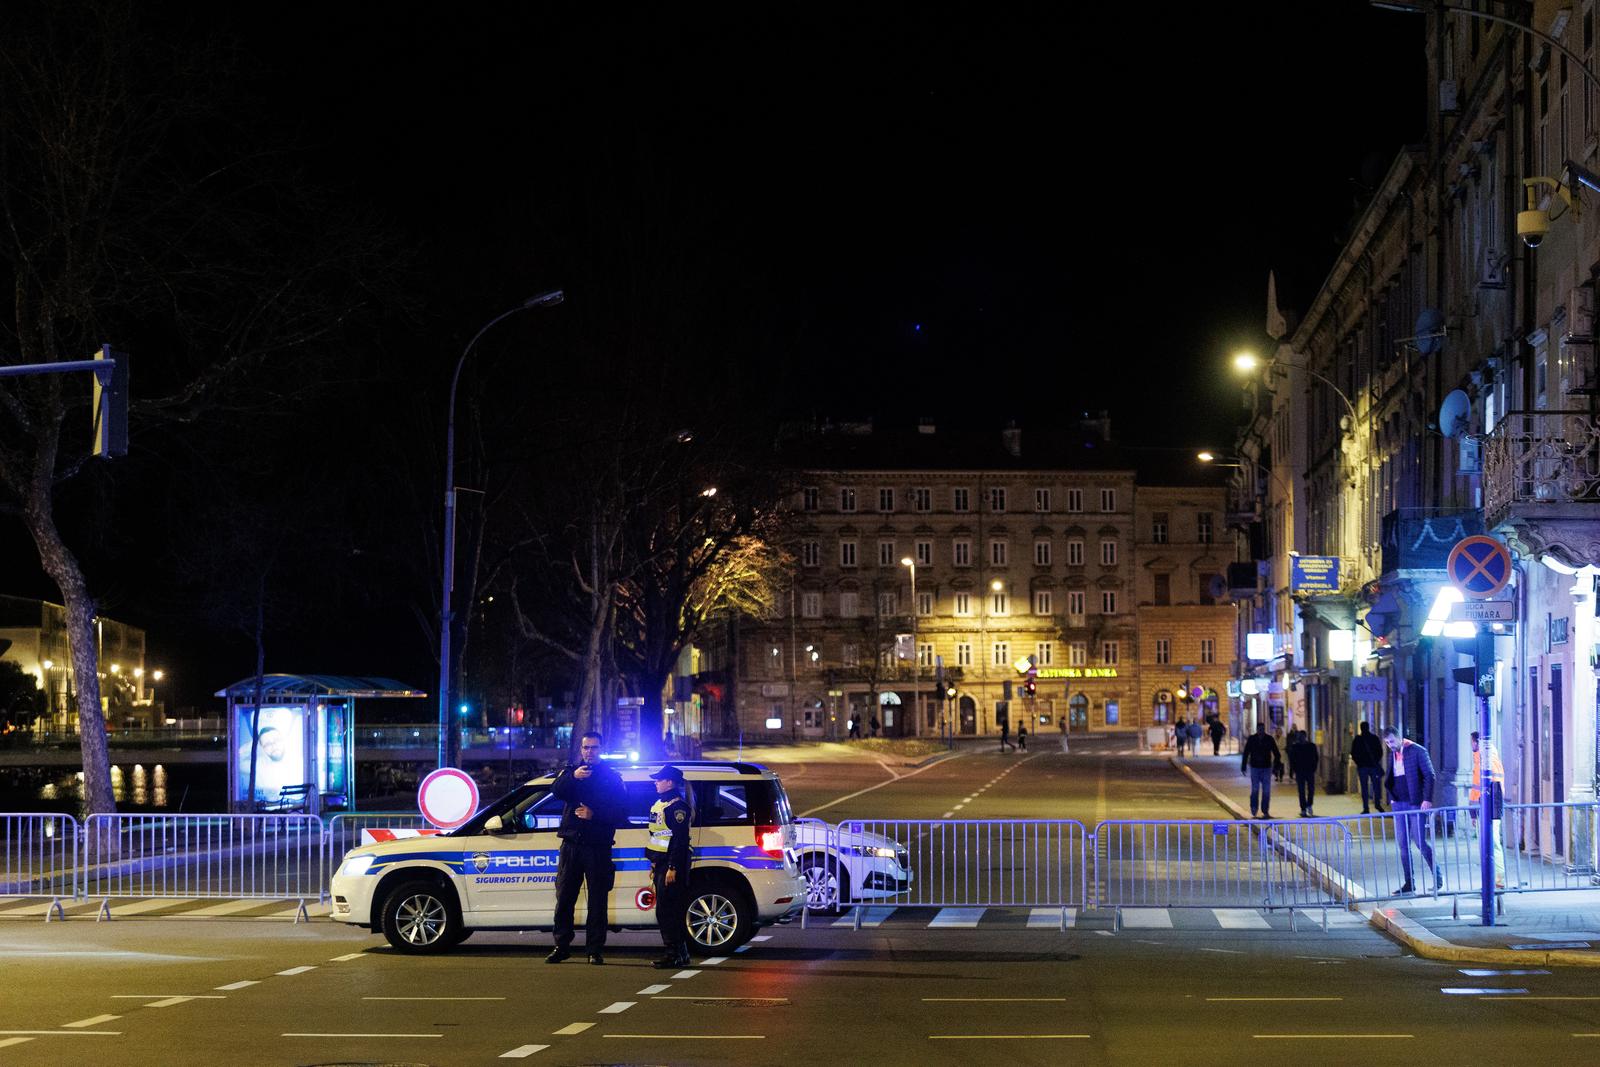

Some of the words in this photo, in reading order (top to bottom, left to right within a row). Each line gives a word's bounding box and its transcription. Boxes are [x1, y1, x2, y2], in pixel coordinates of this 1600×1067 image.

[1036, 668, 1082, 678] LATINSKA
[1084, 668, 1117, 677] BANKA
[496, 856, 560, 866] POLICIJ
